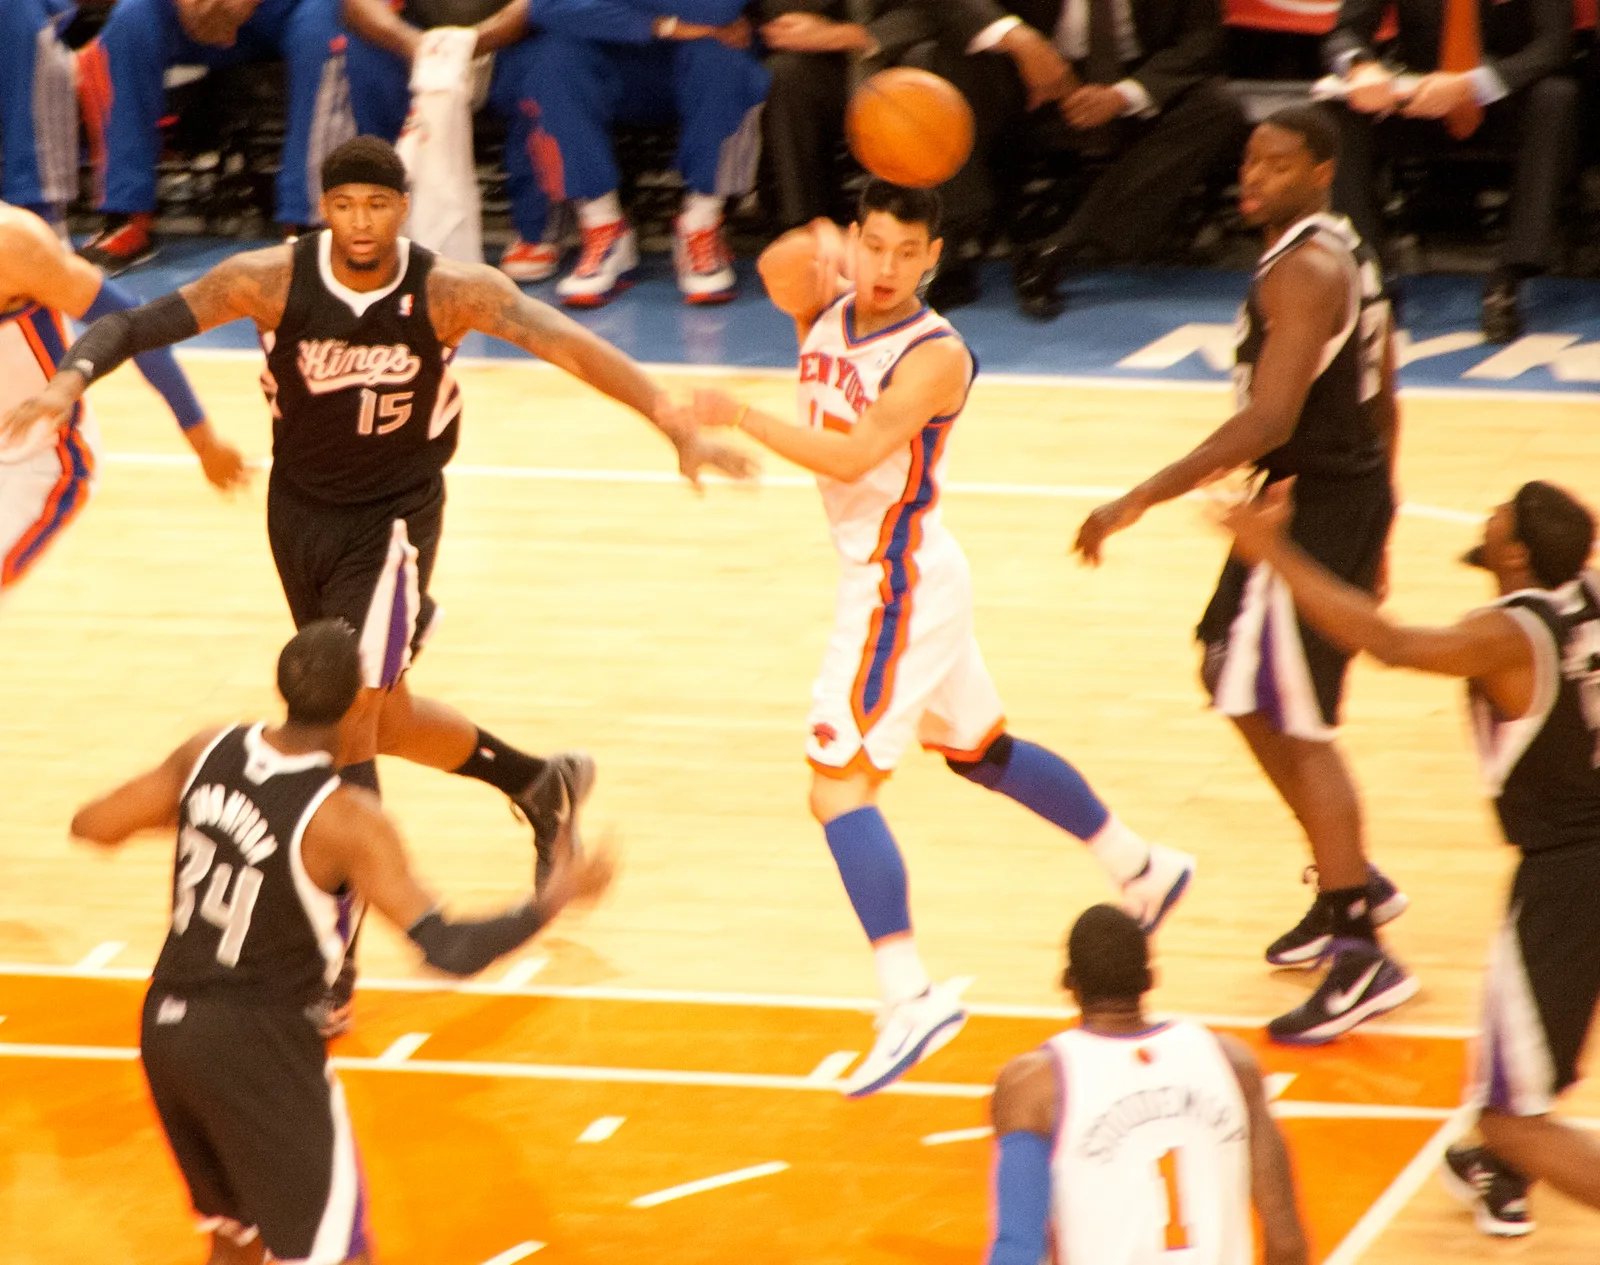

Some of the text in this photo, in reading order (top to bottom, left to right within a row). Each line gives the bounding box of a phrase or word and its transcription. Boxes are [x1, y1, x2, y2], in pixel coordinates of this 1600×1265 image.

[297, 339, 420, 394] Kings
[358, 387, 415, 436] 15
[171, 824, 265, 968] 34
[1153, 1144, 1193, 1252] 1
